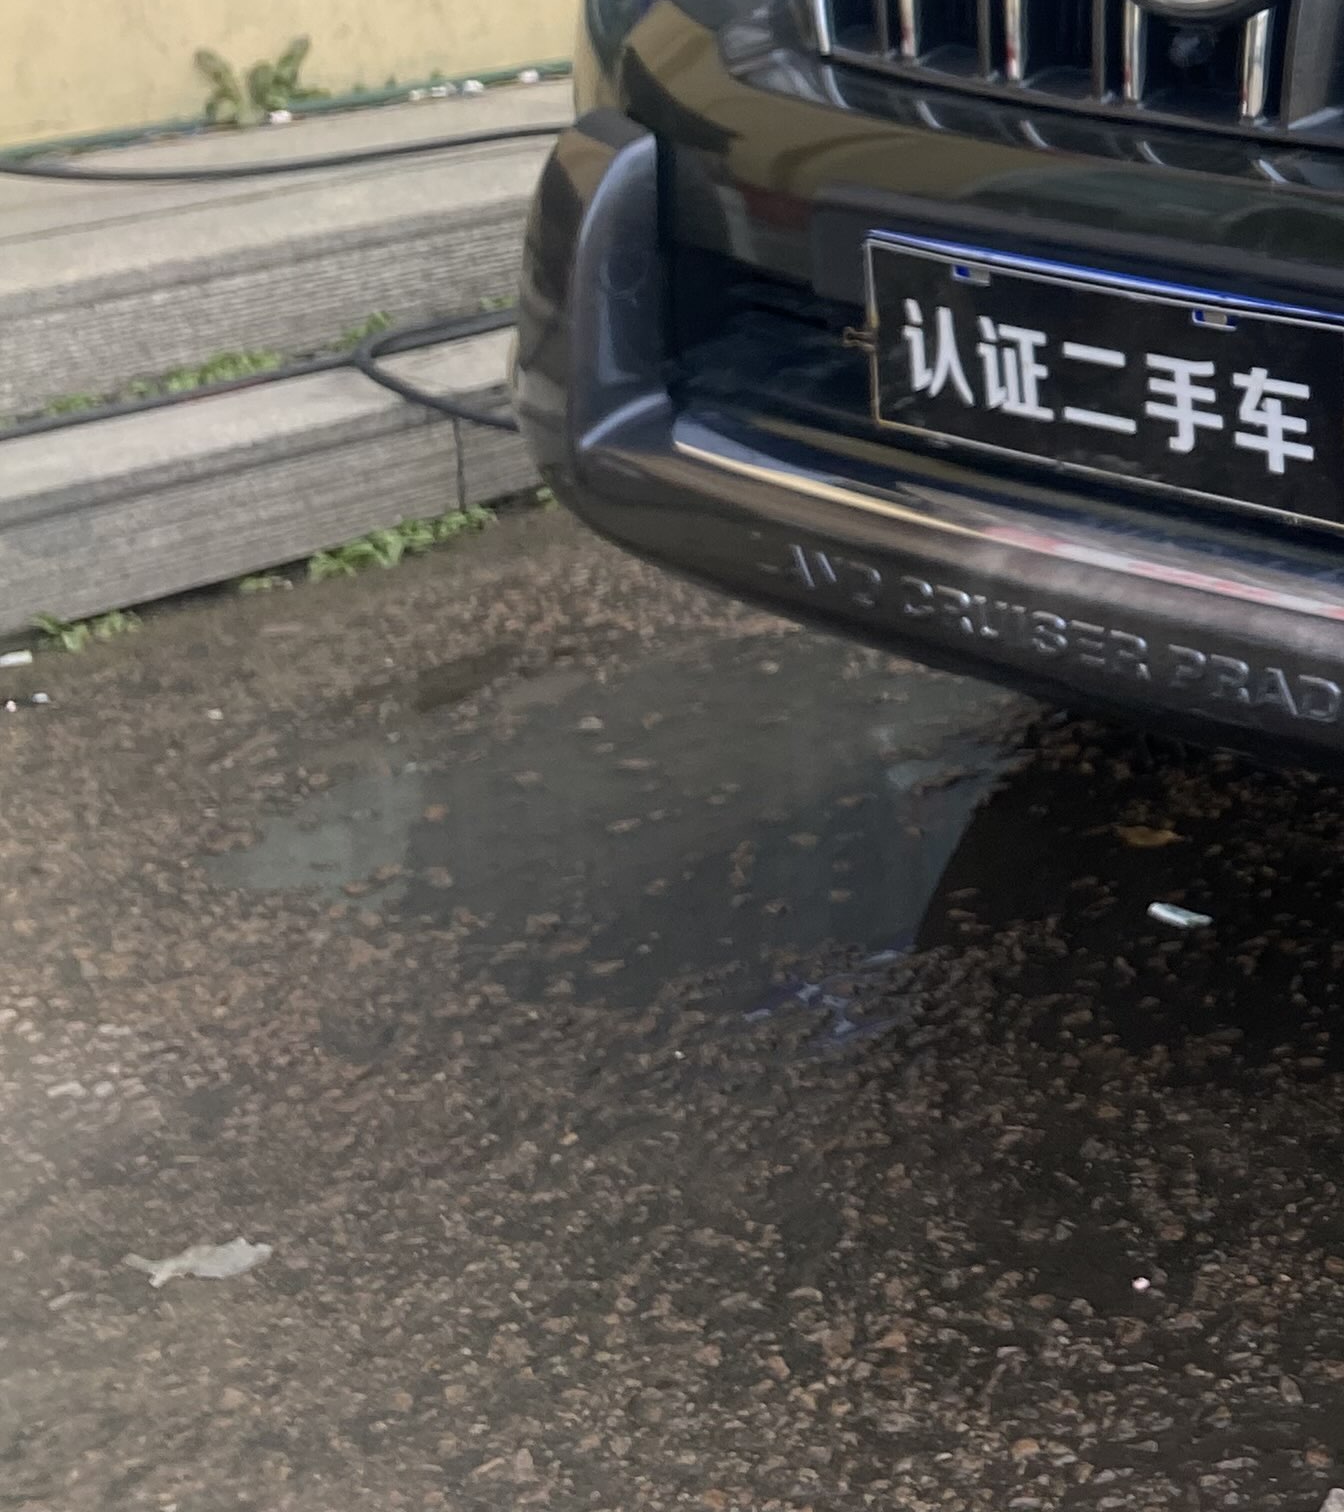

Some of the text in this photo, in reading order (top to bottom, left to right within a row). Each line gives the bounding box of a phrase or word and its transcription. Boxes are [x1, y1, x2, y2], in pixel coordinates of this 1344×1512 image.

[900, 297, 1315, 475] 认证二手车
[902, 574, 1152, 682] CRUISER
